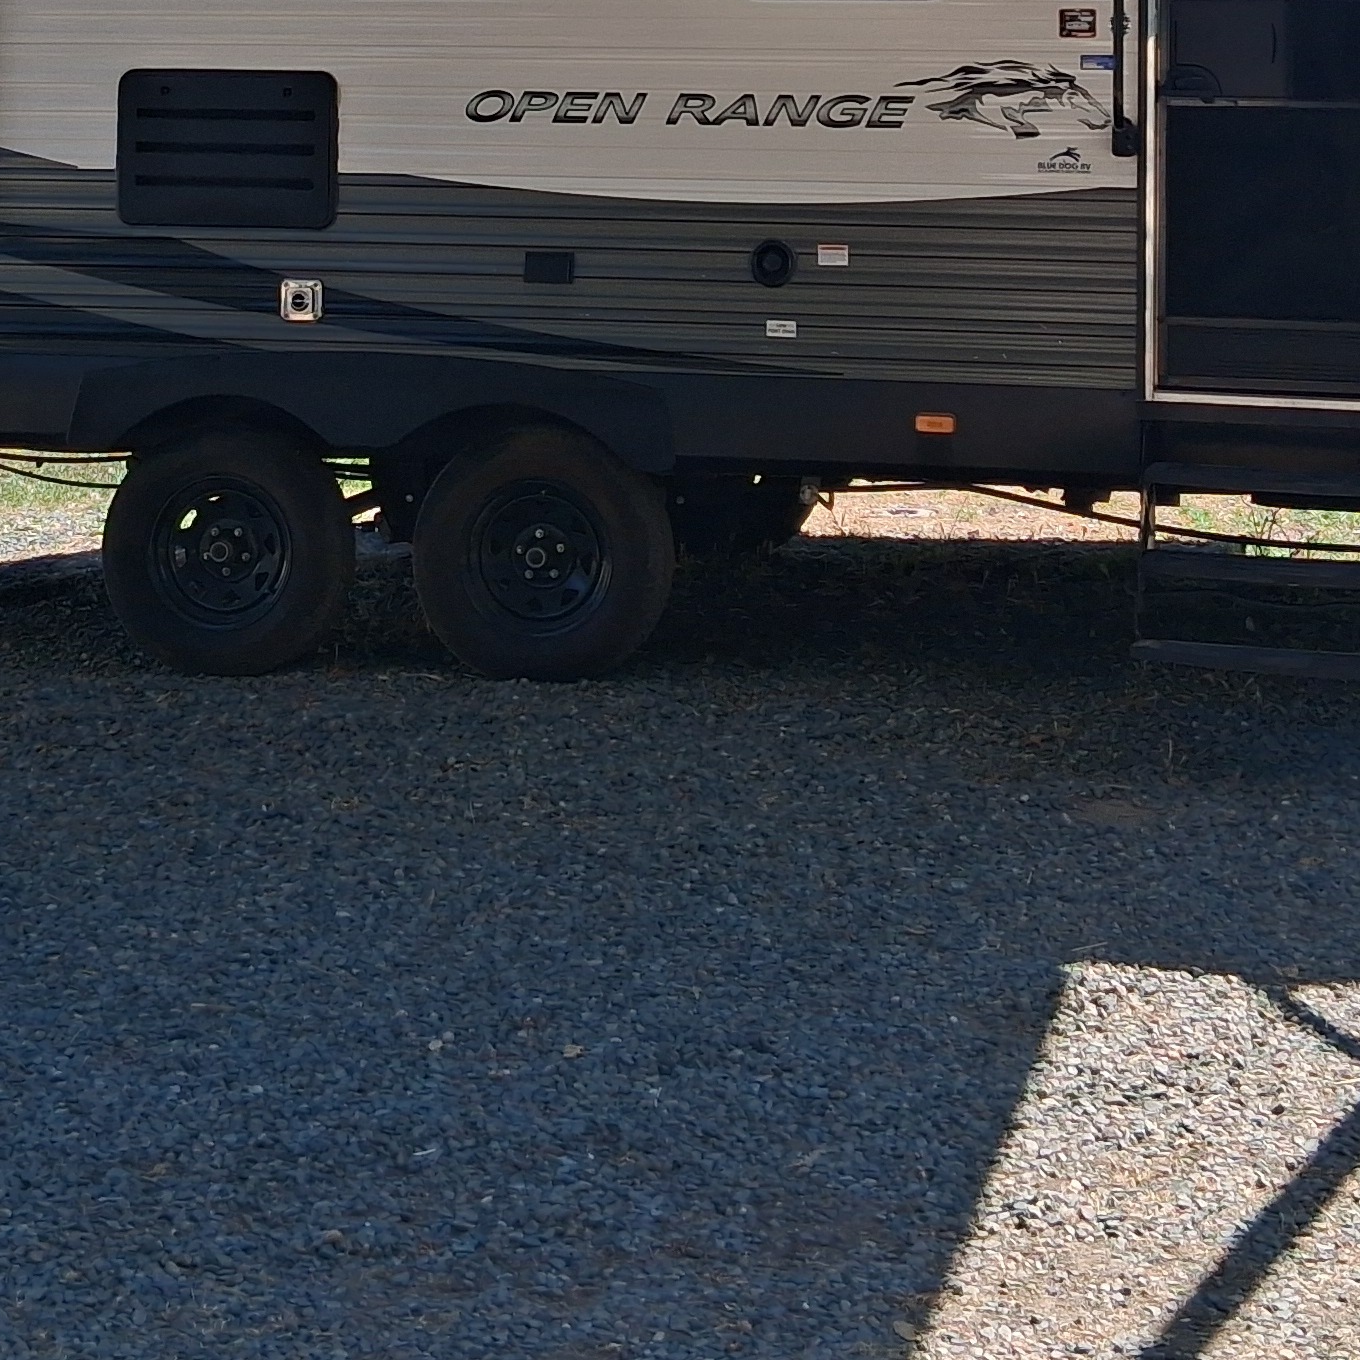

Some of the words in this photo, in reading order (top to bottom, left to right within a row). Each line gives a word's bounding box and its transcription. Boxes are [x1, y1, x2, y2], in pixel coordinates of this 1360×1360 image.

[464, 89, 648, 124] OPEN
[665, 92, 916, 129] RANGE
[1037, 161, 1057, 170] BLUE
[1058, 161, 1079, 170] DOG
[1080, 163, 1092, 171] RV
